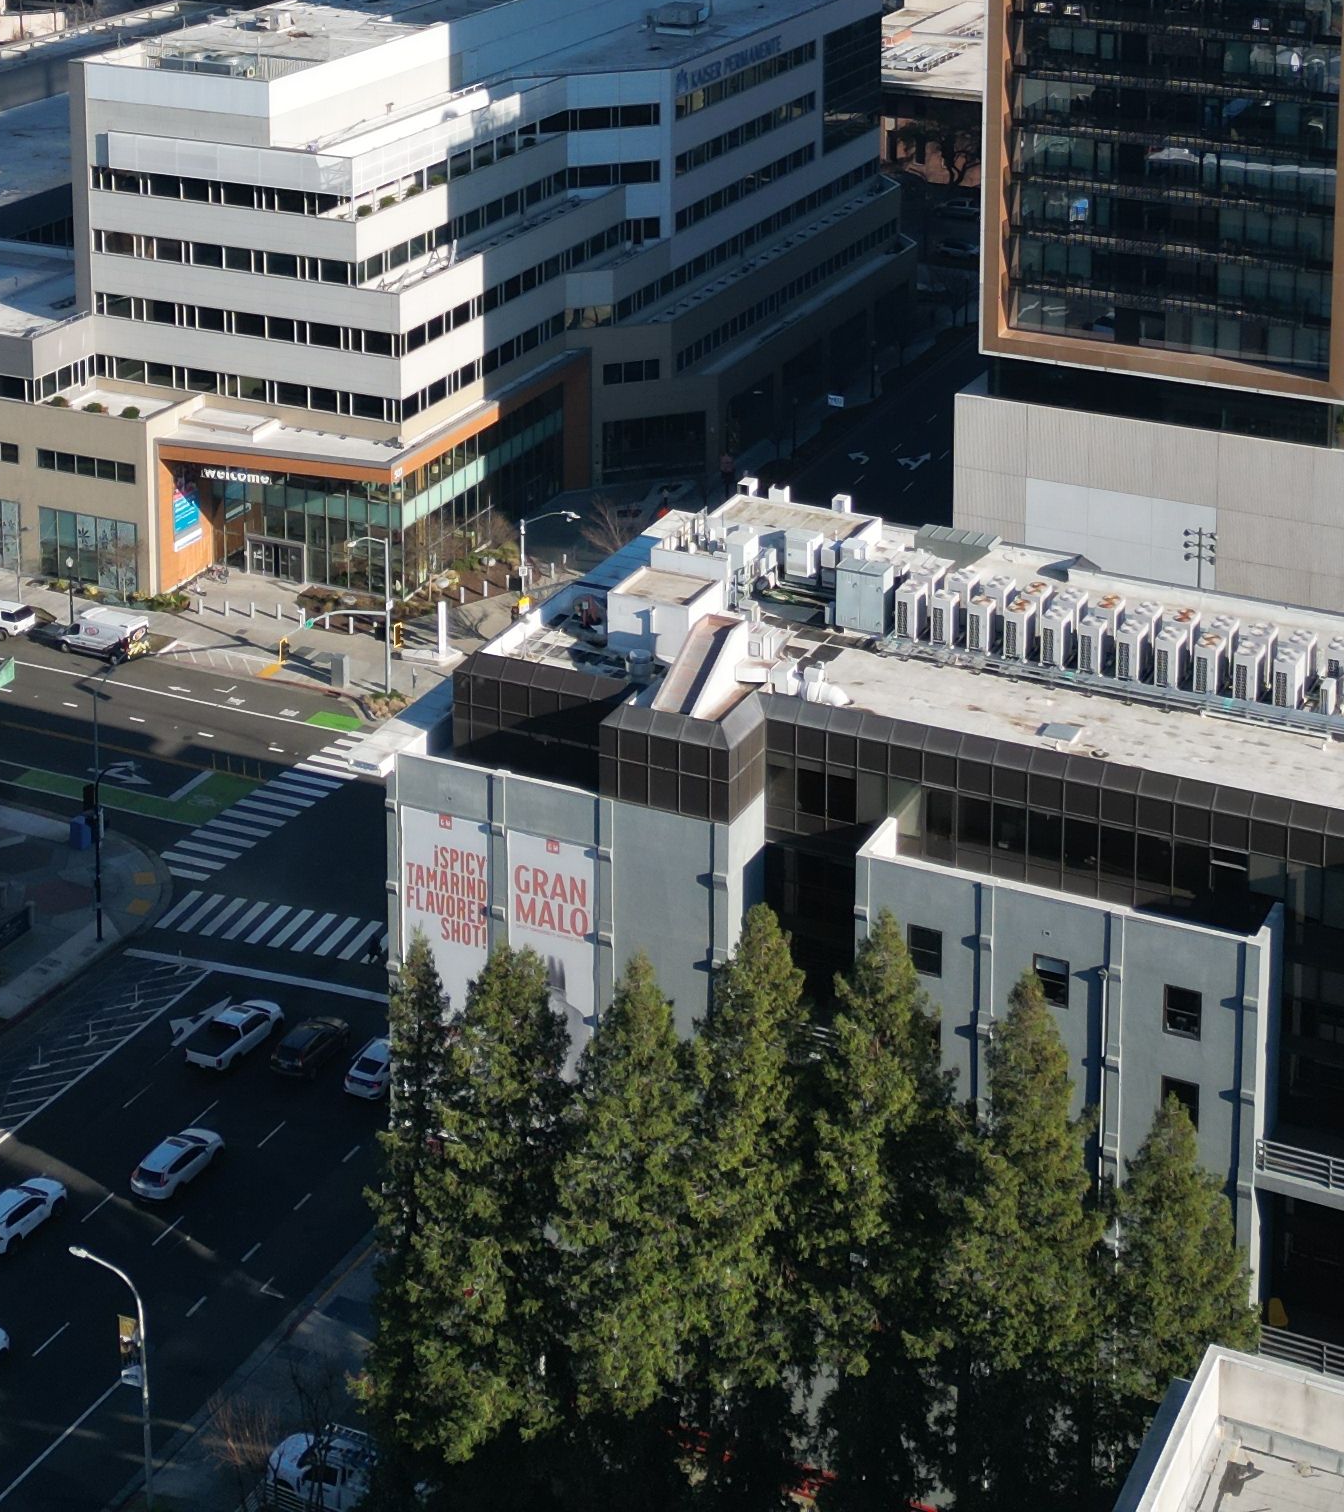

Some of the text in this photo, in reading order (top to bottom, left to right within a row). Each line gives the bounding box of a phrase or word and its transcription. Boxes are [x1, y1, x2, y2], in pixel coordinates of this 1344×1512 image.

[204, 468, 271, 485] welcome
[406, 861, 487, 903] TAMARIND
[514, 864, 587, 908] GRAN
[407, 885, 487, 925] FLAVORED
[515, 893, 588, 937] MALO
[441, 917, 487, 950] SHOT!
